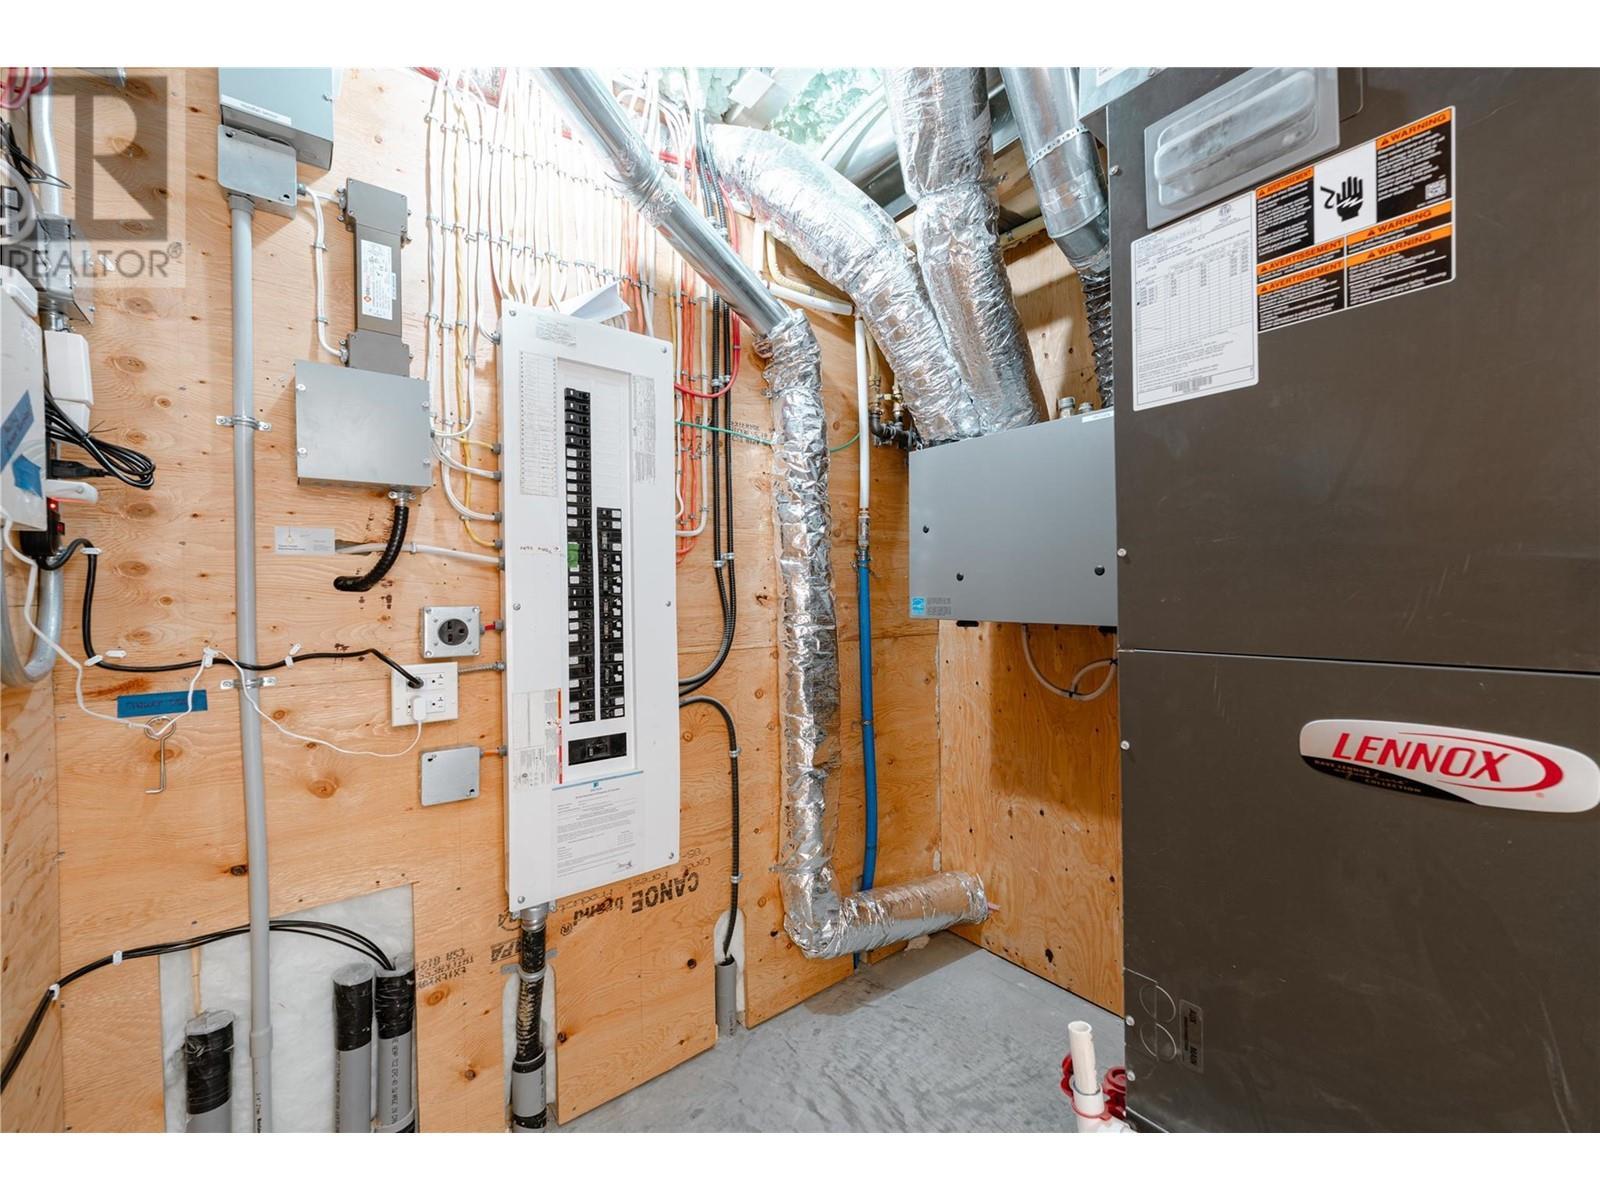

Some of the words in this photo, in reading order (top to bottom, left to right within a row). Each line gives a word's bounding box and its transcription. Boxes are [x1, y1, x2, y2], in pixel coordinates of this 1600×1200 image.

[1391, 113, 1447, 141] WARNING
[1378, 209, 1432, 233] WARNING
[1269, 240, 1342, 269] AVERTISSEMENT
[1378, 232, 1432, 255] WARNING
[1269, 261, 1342, 289] AVERTISSEMENT
[1332, 733, 1510, 783] LENNOX
[1364, 778, 1422, 793] COLLECTION
[631, 871, 700, 914] CANOE
